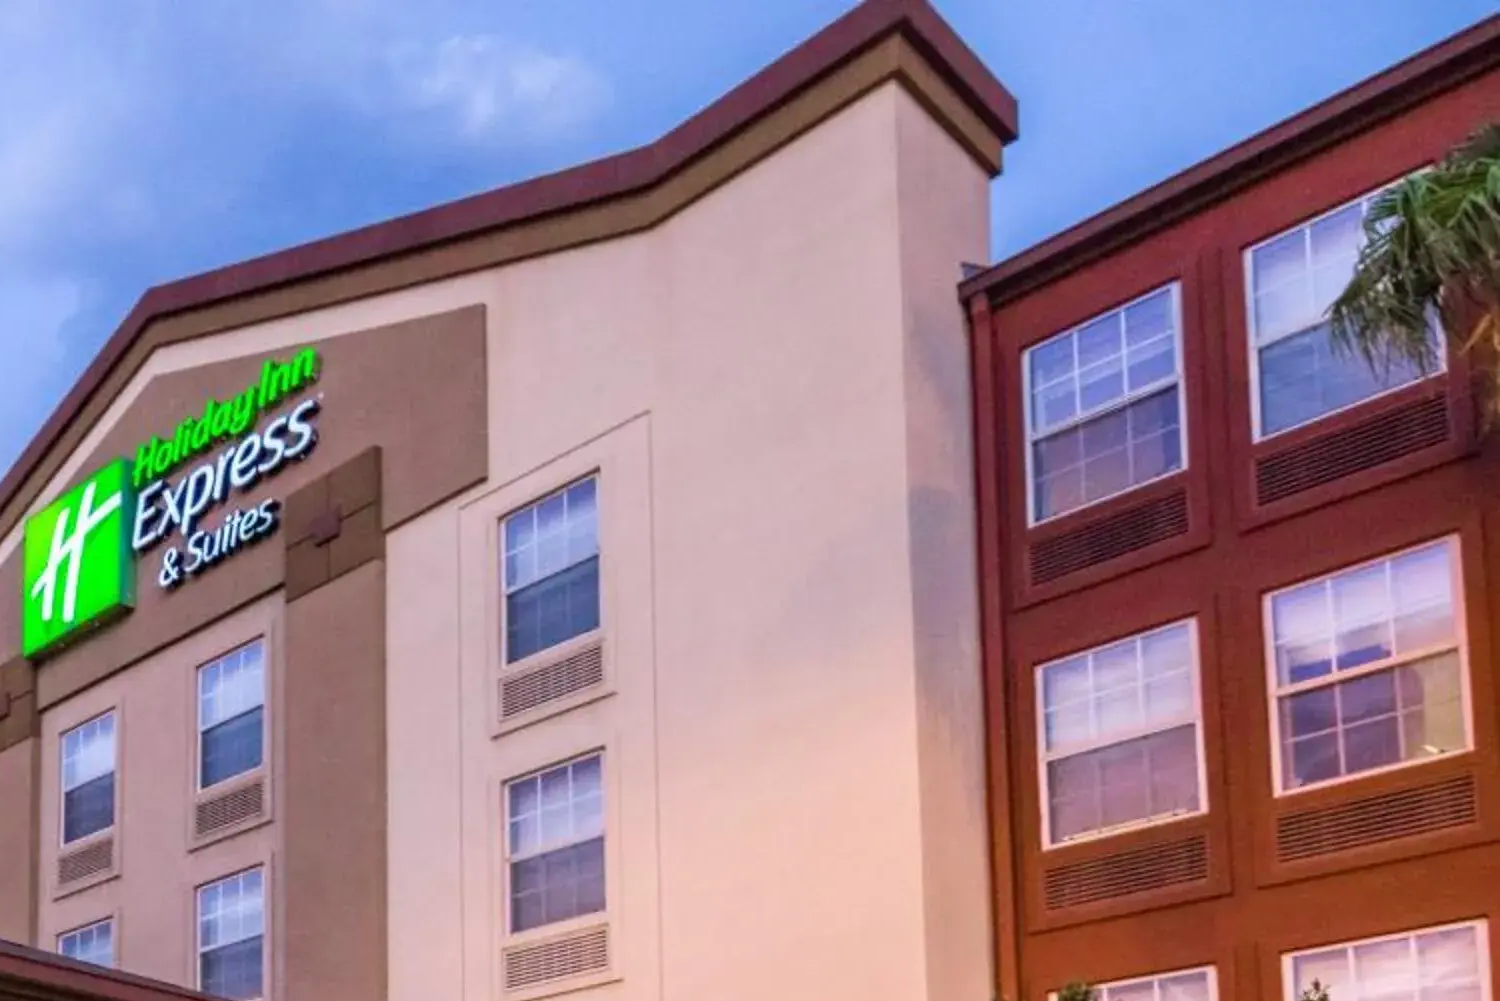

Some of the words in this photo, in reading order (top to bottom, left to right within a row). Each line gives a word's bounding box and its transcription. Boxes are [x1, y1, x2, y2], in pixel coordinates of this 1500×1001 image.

[132, 384, 259, 487] Holiday
[257, 346, 317, 408] Inn
[132, 399, 315, 550] Express
[158, 546, 179, 588] &
[184, 498, 274, 573] Suites
